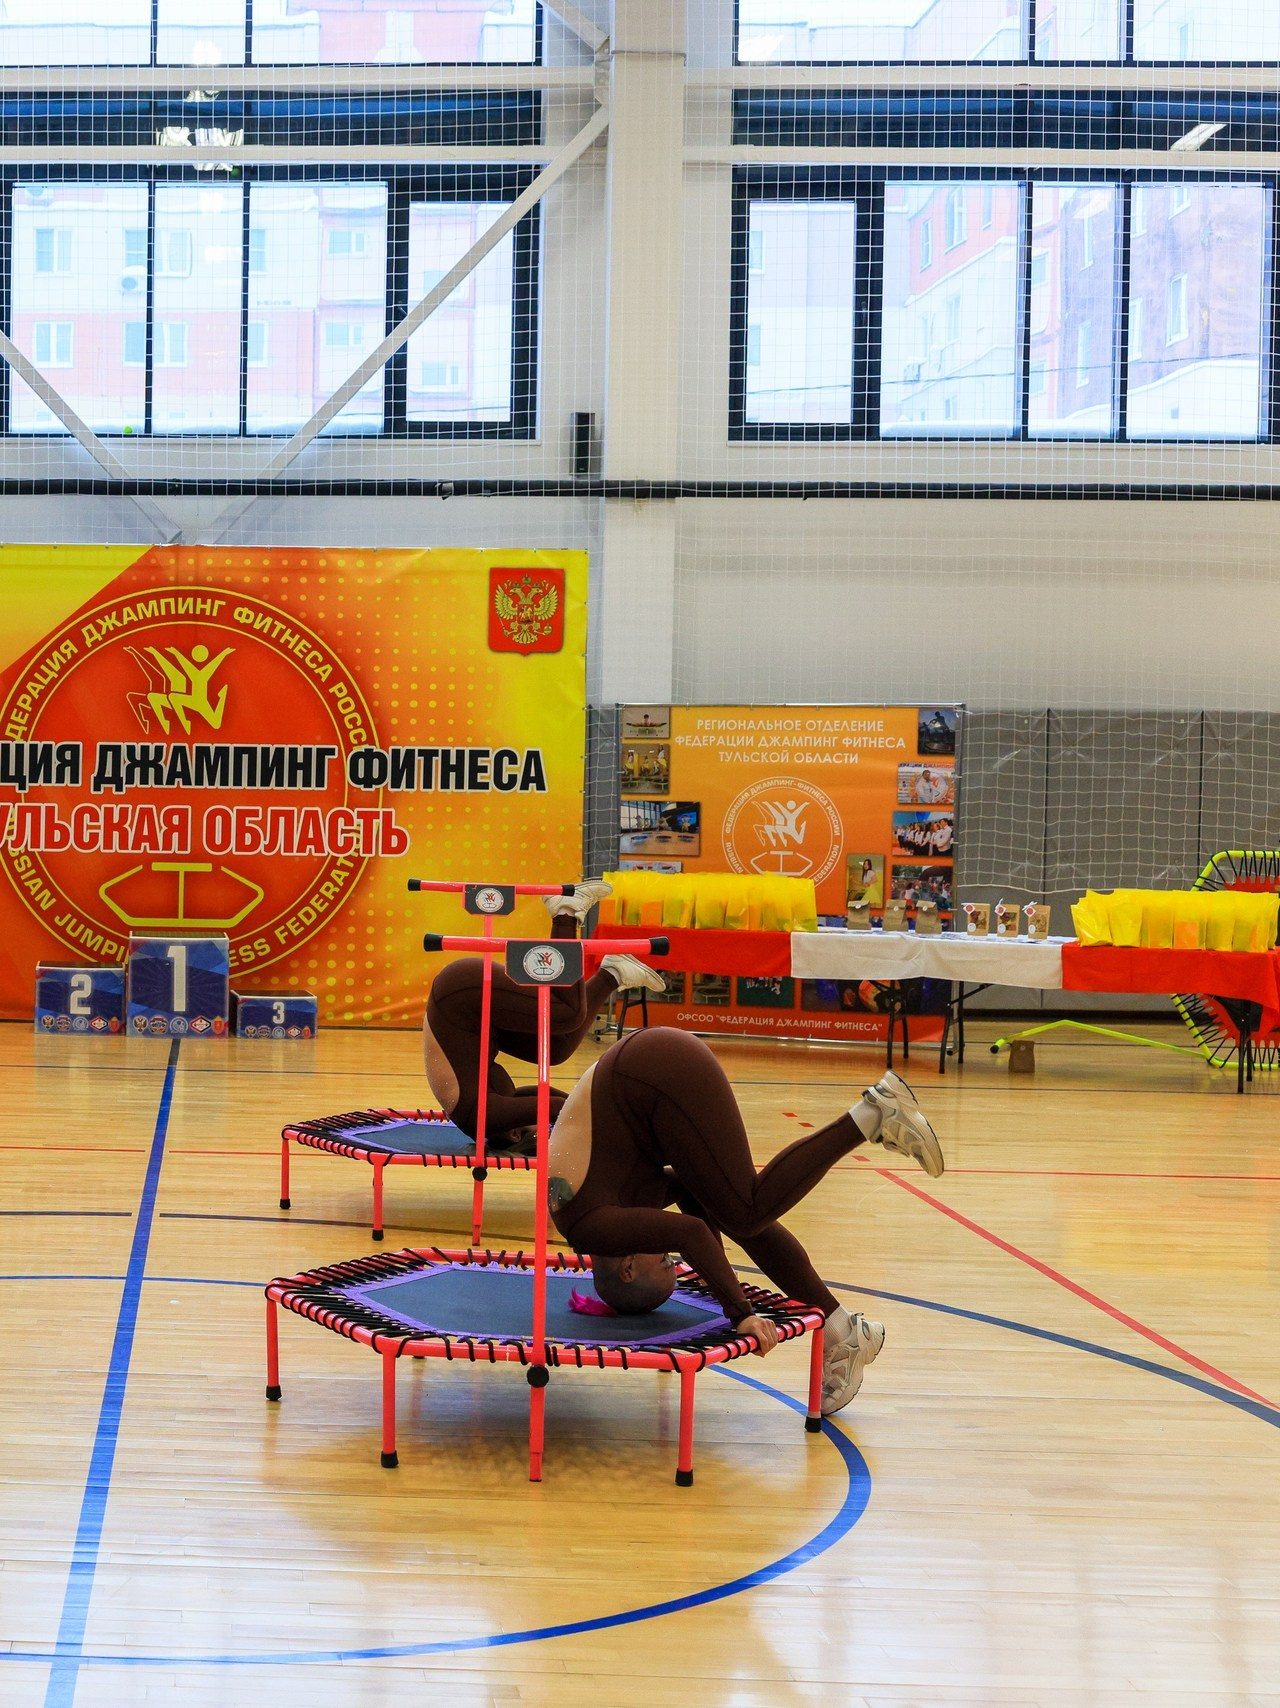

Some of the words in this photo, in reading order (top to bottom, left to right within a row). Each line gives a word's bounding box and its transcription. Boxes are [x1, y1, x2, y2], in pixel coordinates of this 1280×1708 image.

[5, 639, 78, 742] ДЕРАЦИЯ
[81, 597, 226, 648] ДЖАМПИНГ
[233, 607, 333, 682] ФИТНЕСА
[329, 681, 369, 750] РОСС
[675, 735, 754, 747] ФЕДЕРАЦИИ
[758, 736, 838, 748] ДЖАМПИНГ
[842, 737, 906, 749] ФИТНЕСА
[697, 719, 801, 731] РЕГИОНАЛЬНОЕ
[806, 720, 884, 732] ОТДЕЛЕНИЕ
[91, 741, 338, 795] ДЖАМПИНГ
[347, 745, 548, 794] ФИТНЕСА
[719, 749, 789, 763] ТУЛЬСКОЙ
[794, 752, 858, 764] ОБЛАСТИ
[202, 805, 410, 858] ОБЛАСТЬ
[826, 806, 841, 836] РОССИИ
[726, 842, 744, 873] RUSSIAN
[813, 844, 840, 883] EDERATION
[274, 822, 360, 945] FEDERAT
[54, 913, 129, 964] JUMPI
[70, 974, 92, 1015] 2
[167, 945, 187, 1012] 1
[272, 1001, 285, 1024] 3
[676, 1013, 714, 1022] ОФСОО
[716, 1015, 774, 1026] "ФЕДЕРАЦИЯ
[776, 1018, 832, 1030] ДЖАМПИНГ
[834, 1021, 882, 1032] ФИТНЕСА"
